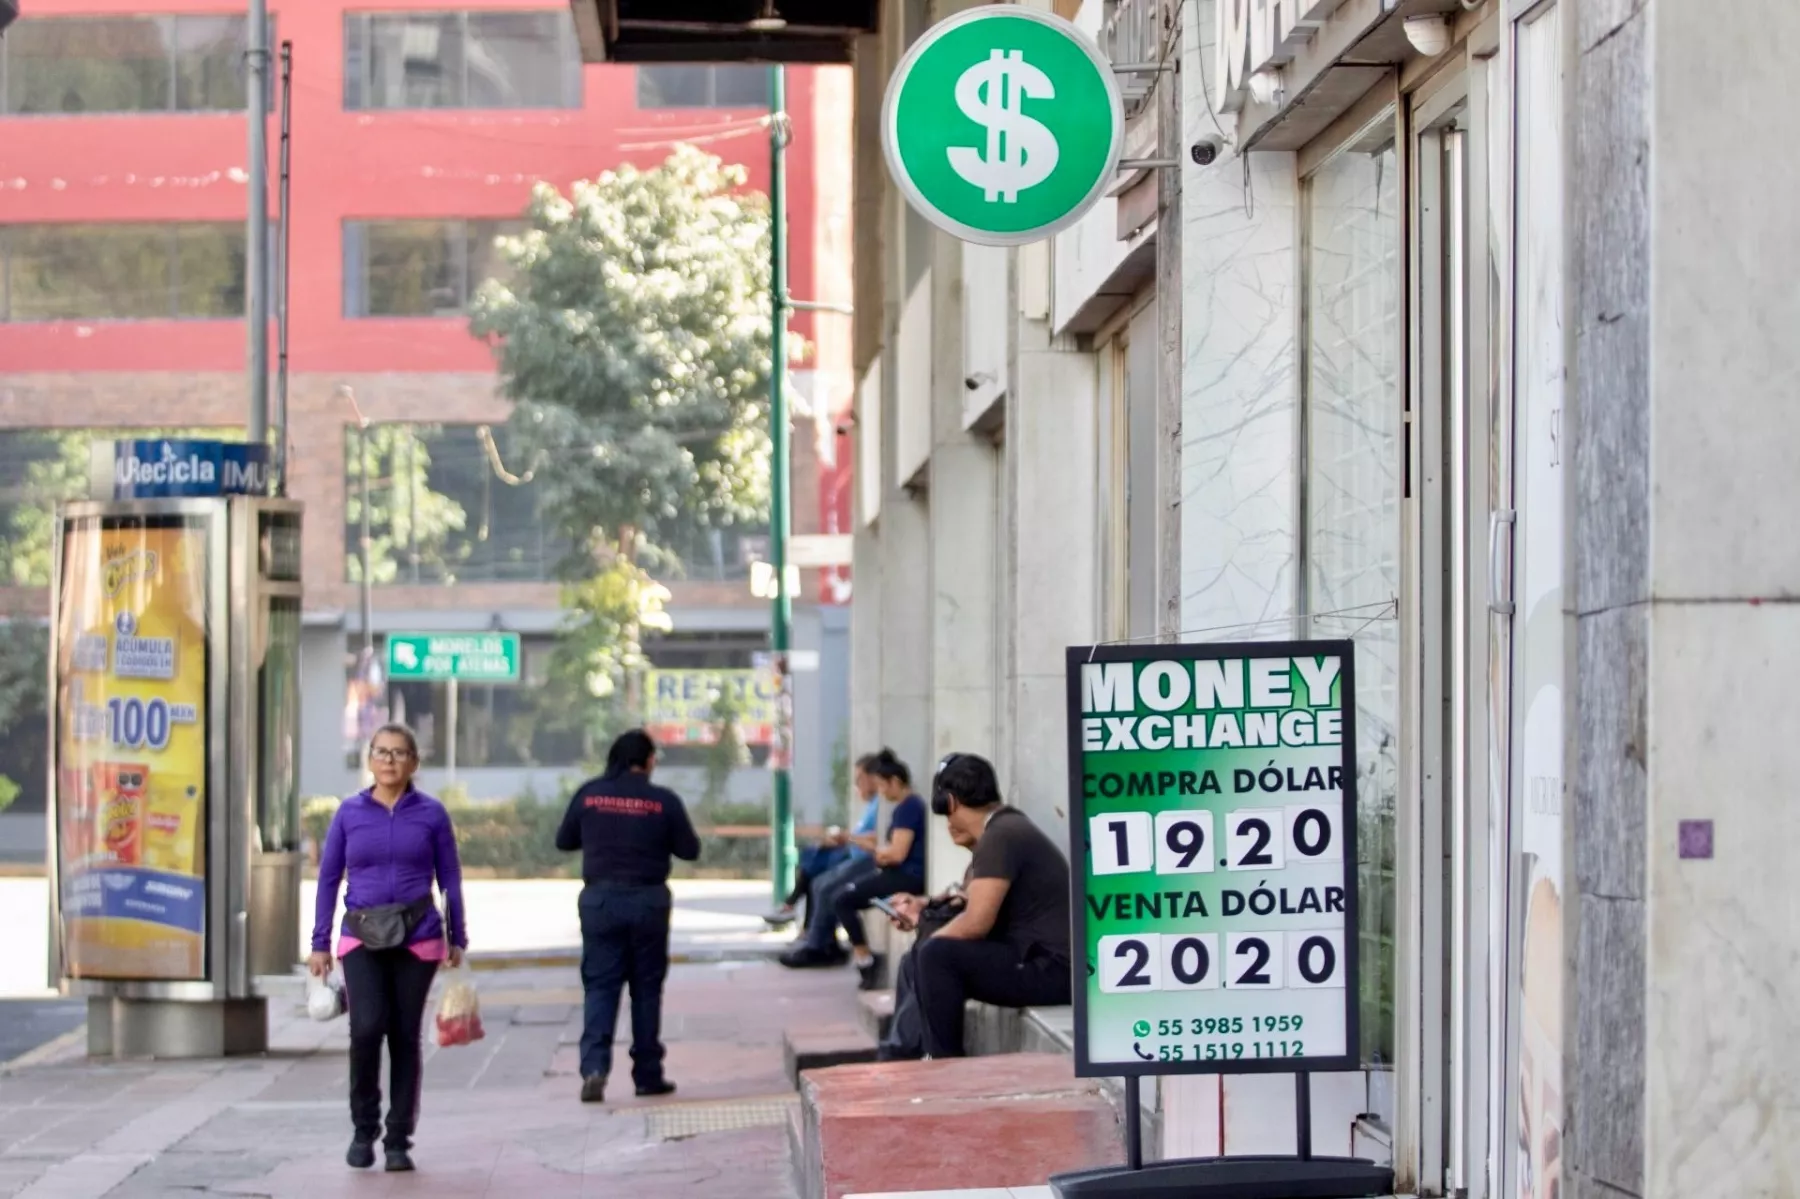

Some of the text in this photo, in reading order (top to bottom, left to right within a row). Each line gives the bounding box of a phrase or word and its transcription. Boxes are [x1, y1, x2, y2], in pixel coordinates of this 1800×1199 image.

[947, 48, 1059, 203] $
[1081, 656, 1341, 712] MONEY
[107, 697, 169, 747] 100
[1082, 710, 1342, 751] EXCHANGE
[1083, 759, 1343, 798] COMPRA DÓLAR
[1108, 808, 1331, 868] 19.20
[1087, 880, 1344, 921] VENTA DÓLAR
[1158, 1015, 1303, 1036] 55 3985 1959
[1159, 1040, 1304, 1062] 55 1519 1112
